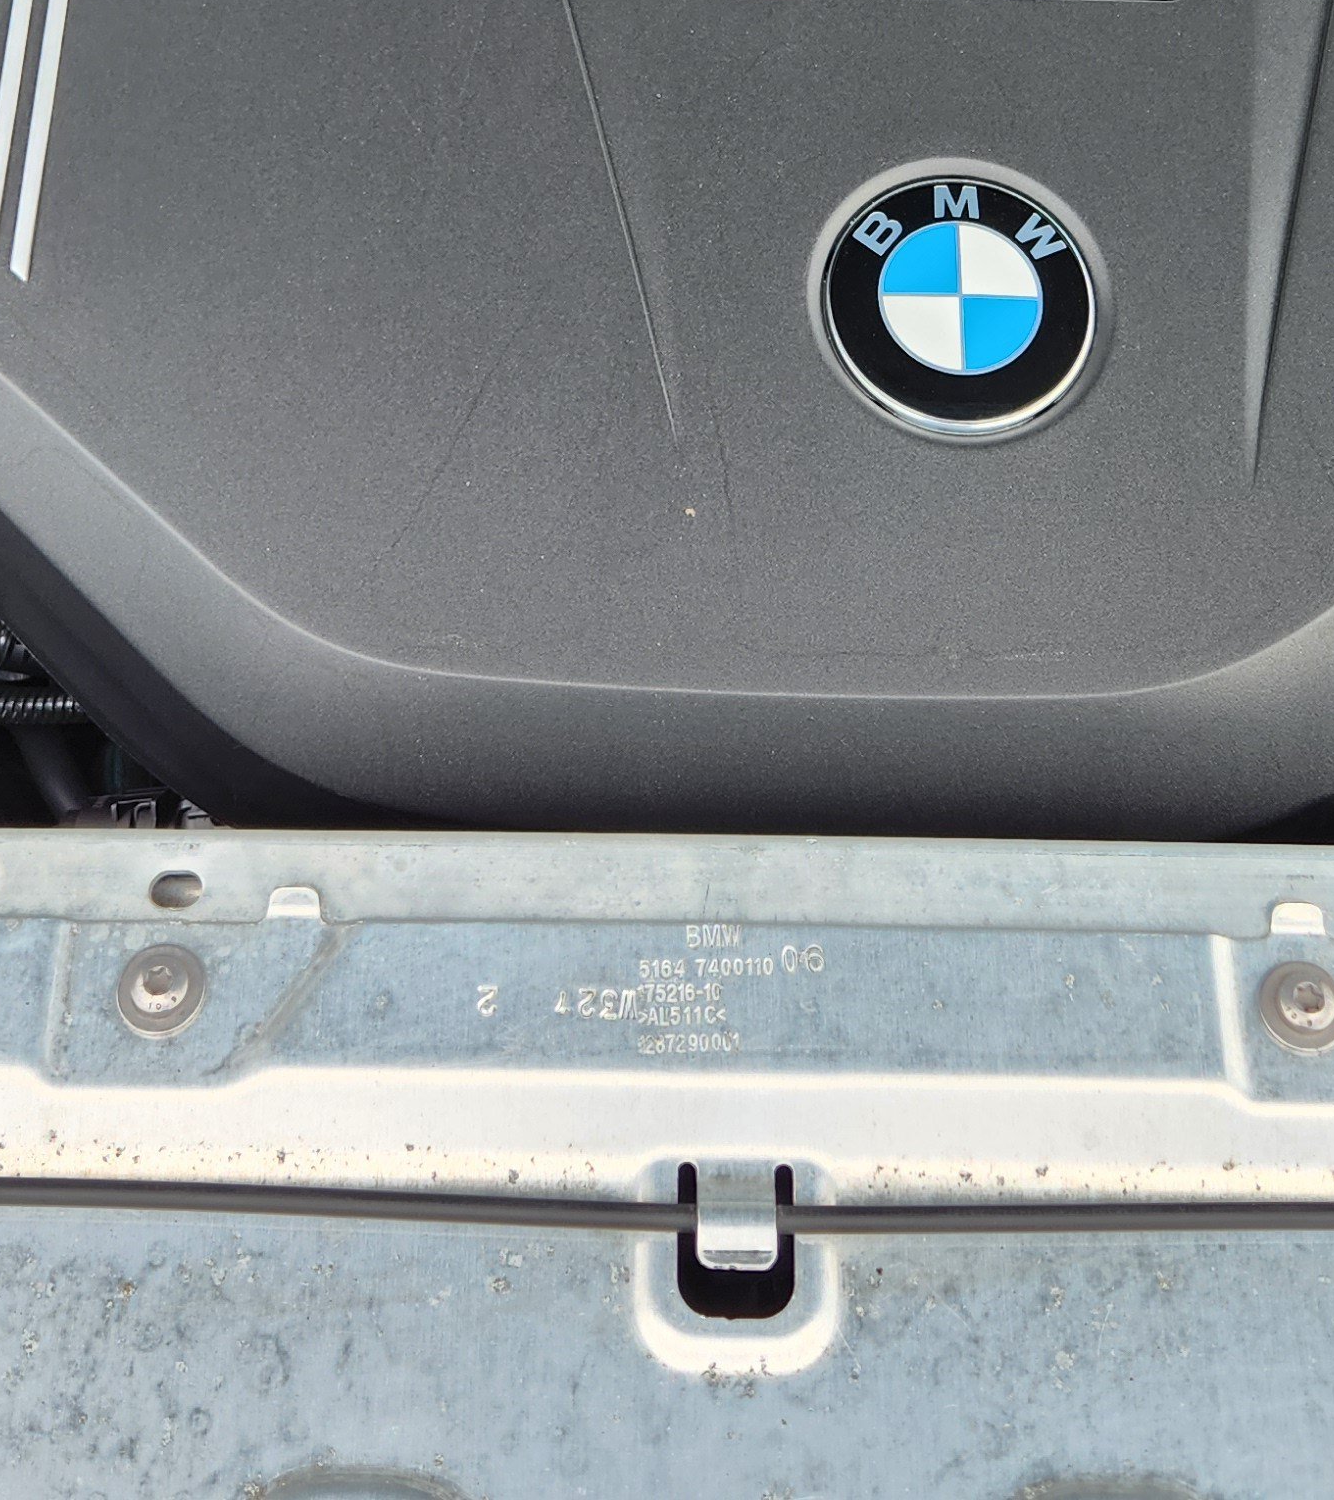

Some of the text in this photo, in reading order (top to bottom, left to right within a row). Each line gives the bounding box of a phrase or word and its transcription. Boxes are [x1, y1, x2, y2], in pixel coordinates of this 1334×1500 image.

[852, 184, 1066, 260] BMW
[685, 924, 742, 948] BMW
[638, 957, 774, 978] 5164 7400110
